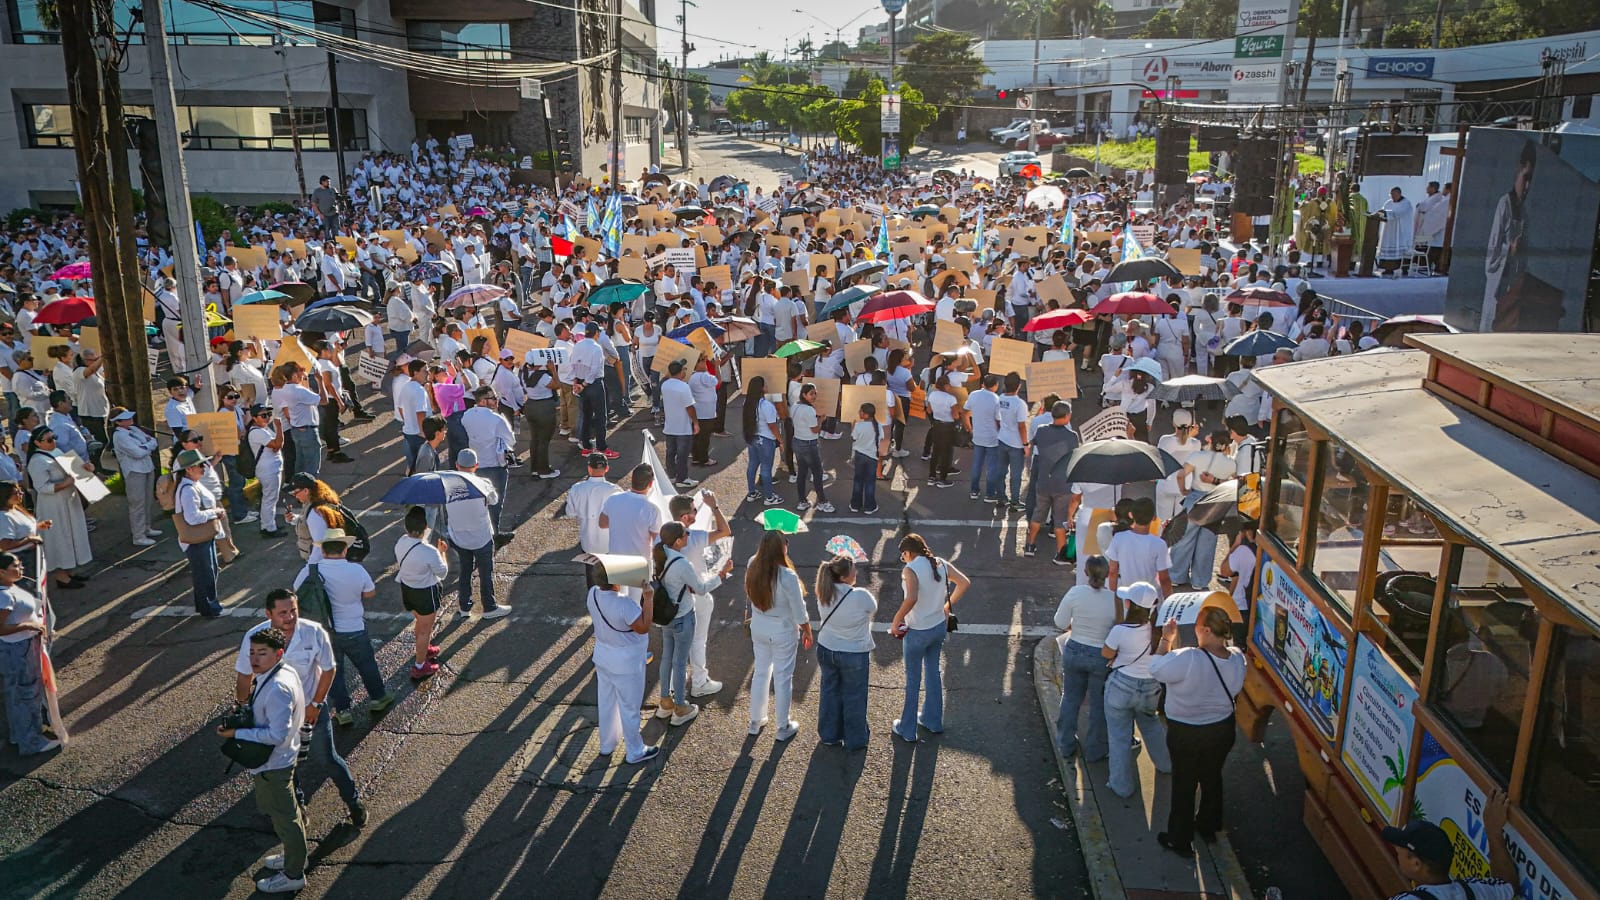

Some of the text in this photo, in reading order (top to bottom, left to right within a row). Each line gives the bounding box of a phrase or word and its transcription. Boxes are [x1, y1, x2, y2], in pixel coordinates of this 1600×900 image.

[1245, 69, 1276, 79] zasshi
[1375, 62, 1426, 73] CHOPO
[1364, 701, 1395, 744] Manzanillo
[1465, 788, 1482, 816] ES
[1456, 831, 1483, 871] ESTAS
